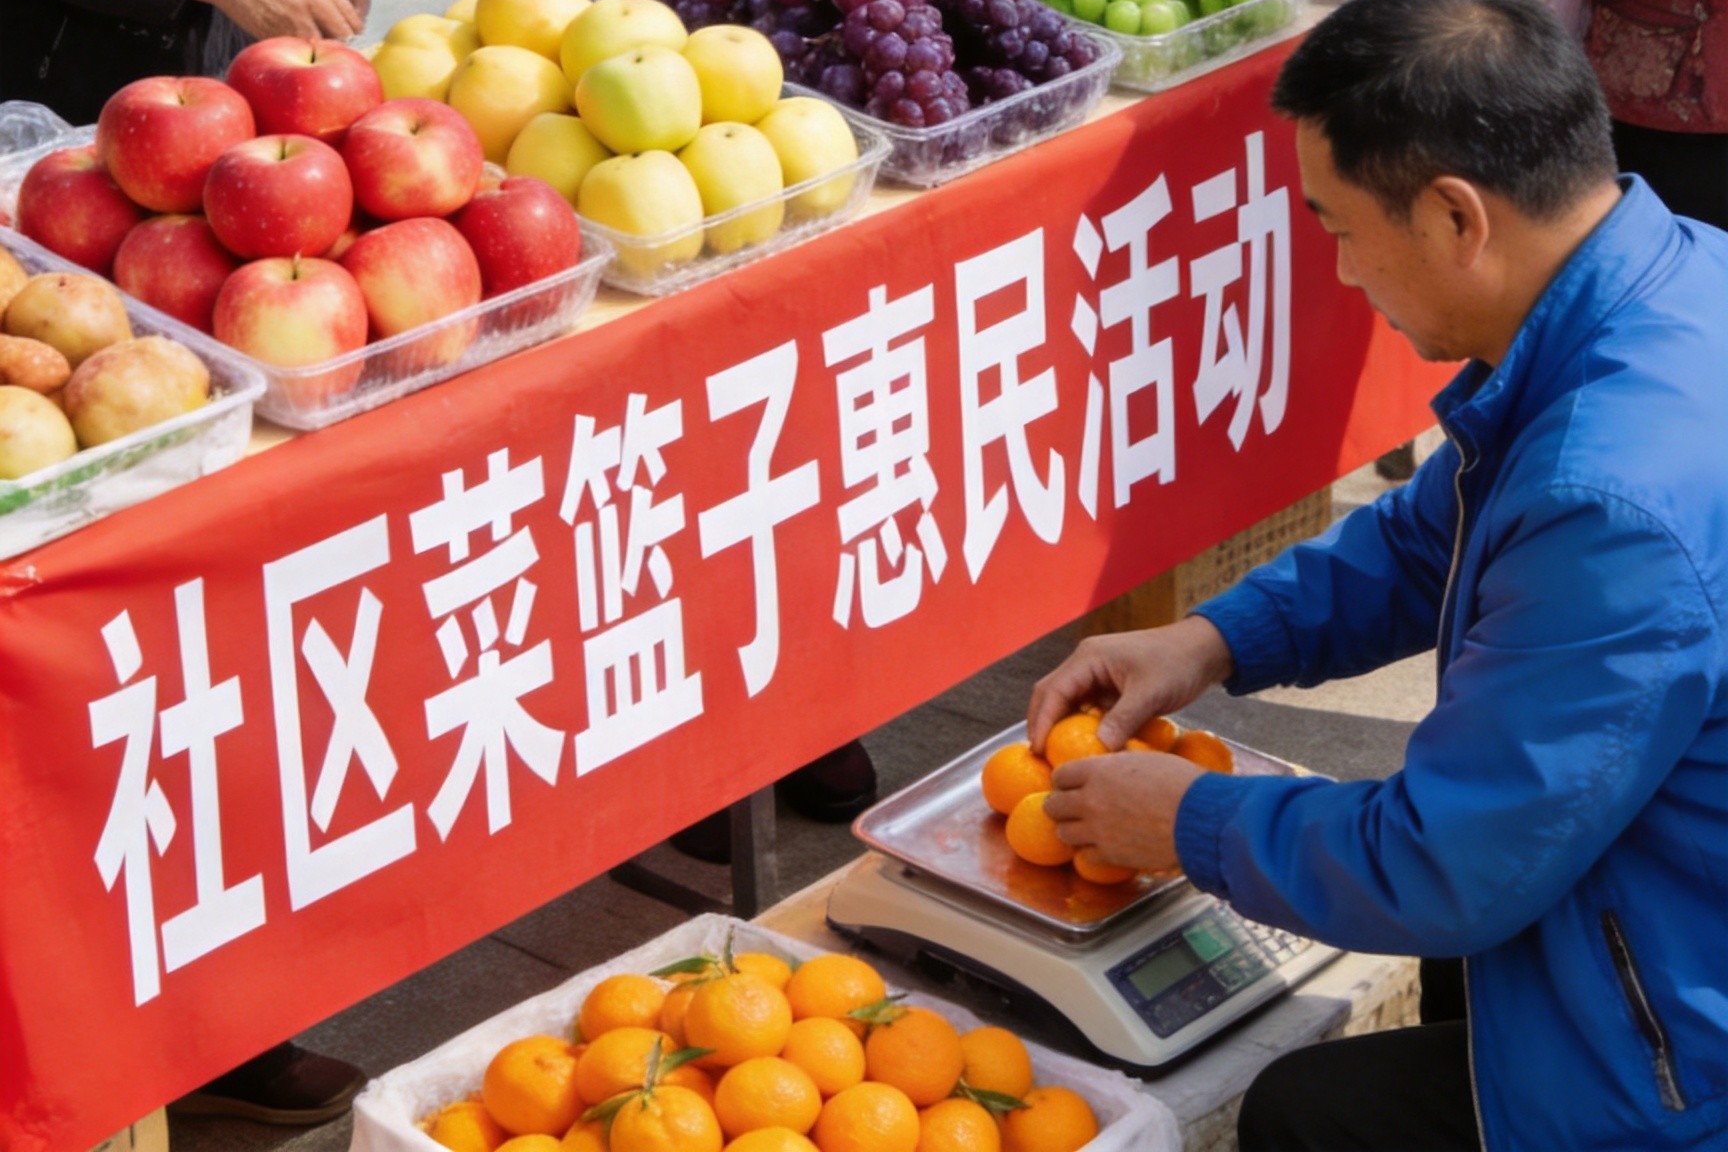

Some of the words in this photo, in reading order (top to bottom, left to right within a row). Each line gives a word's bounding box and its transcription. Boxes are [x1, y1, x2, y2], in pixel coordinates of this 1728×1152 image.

[88, 131, 1292, 1007] 社区菜篮子惠民活动
